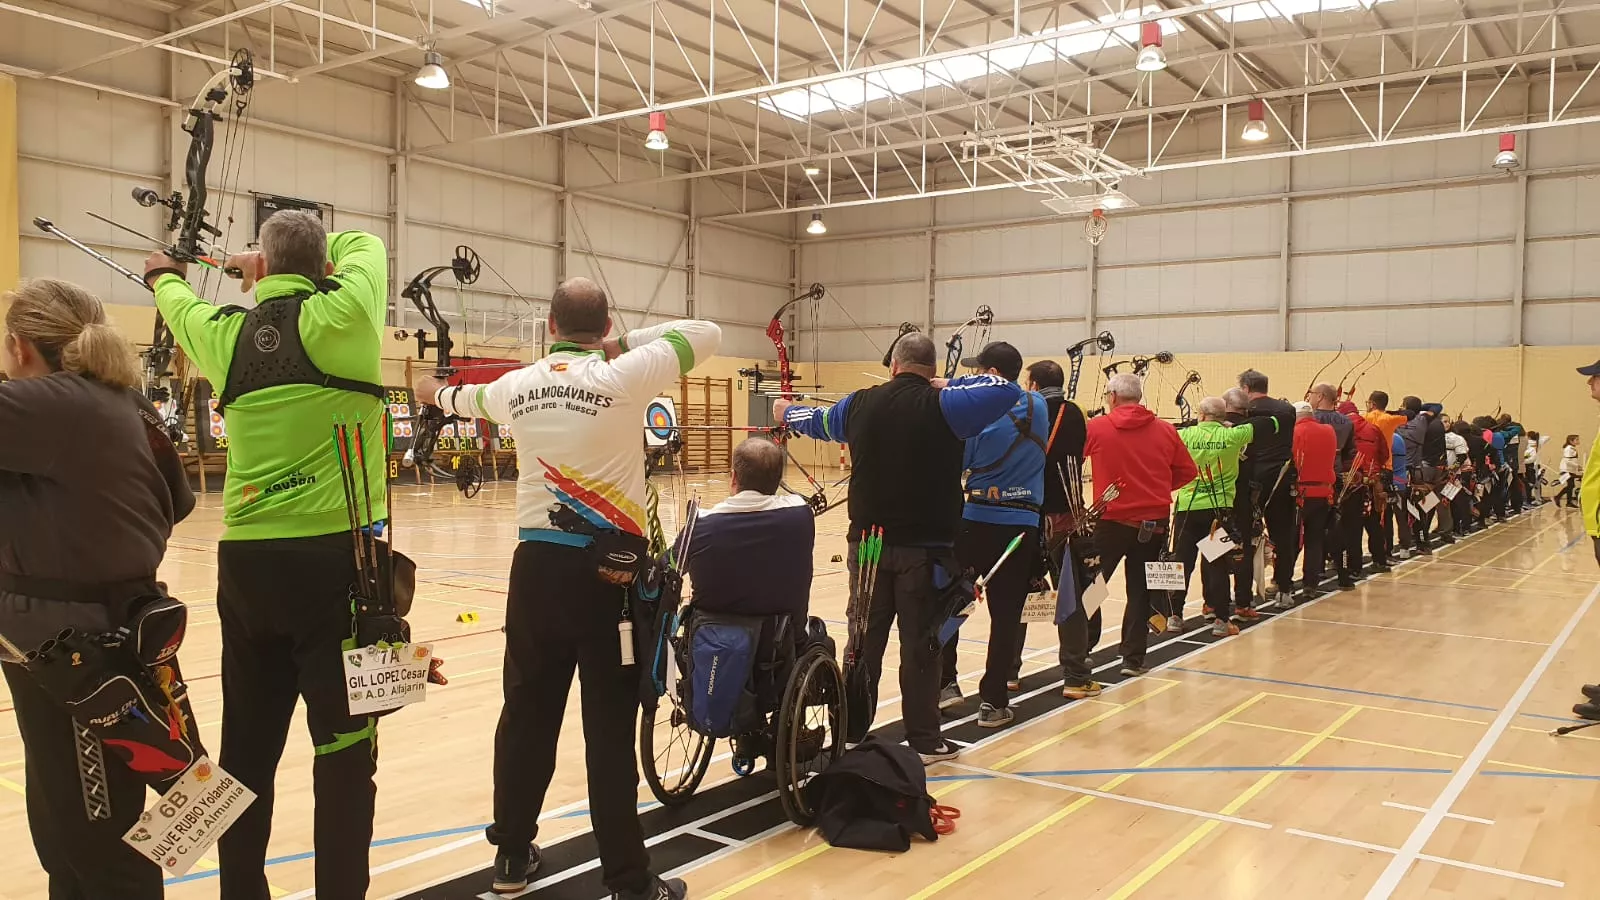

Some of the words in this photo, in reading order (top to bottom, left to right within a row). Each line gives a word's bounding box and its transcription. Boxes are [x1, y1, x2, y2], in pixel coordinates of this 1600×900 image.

[528, 385, 613, 408] ALMOGÁVARES
[525, 403, 539, 414] con
[541, 402, 557, 410] arco
[565, 401, 598, 417] Huesca
[349, 676, 368, 688] GIL
[370, 669, 400, 686] LOPEZ
[401, 668, 427, 680] Cesar
[365, 688, 388, 700] A.D.
[160, 791, 188, 818] 6B
[188, 828, 205, 843] La
[203, 786, 245, 828] Almunia
[151, 831, 180, 861] JULVE
[175, 806, 205, 835] RUBIO
[199, 777, 234, 809] Yolanda
